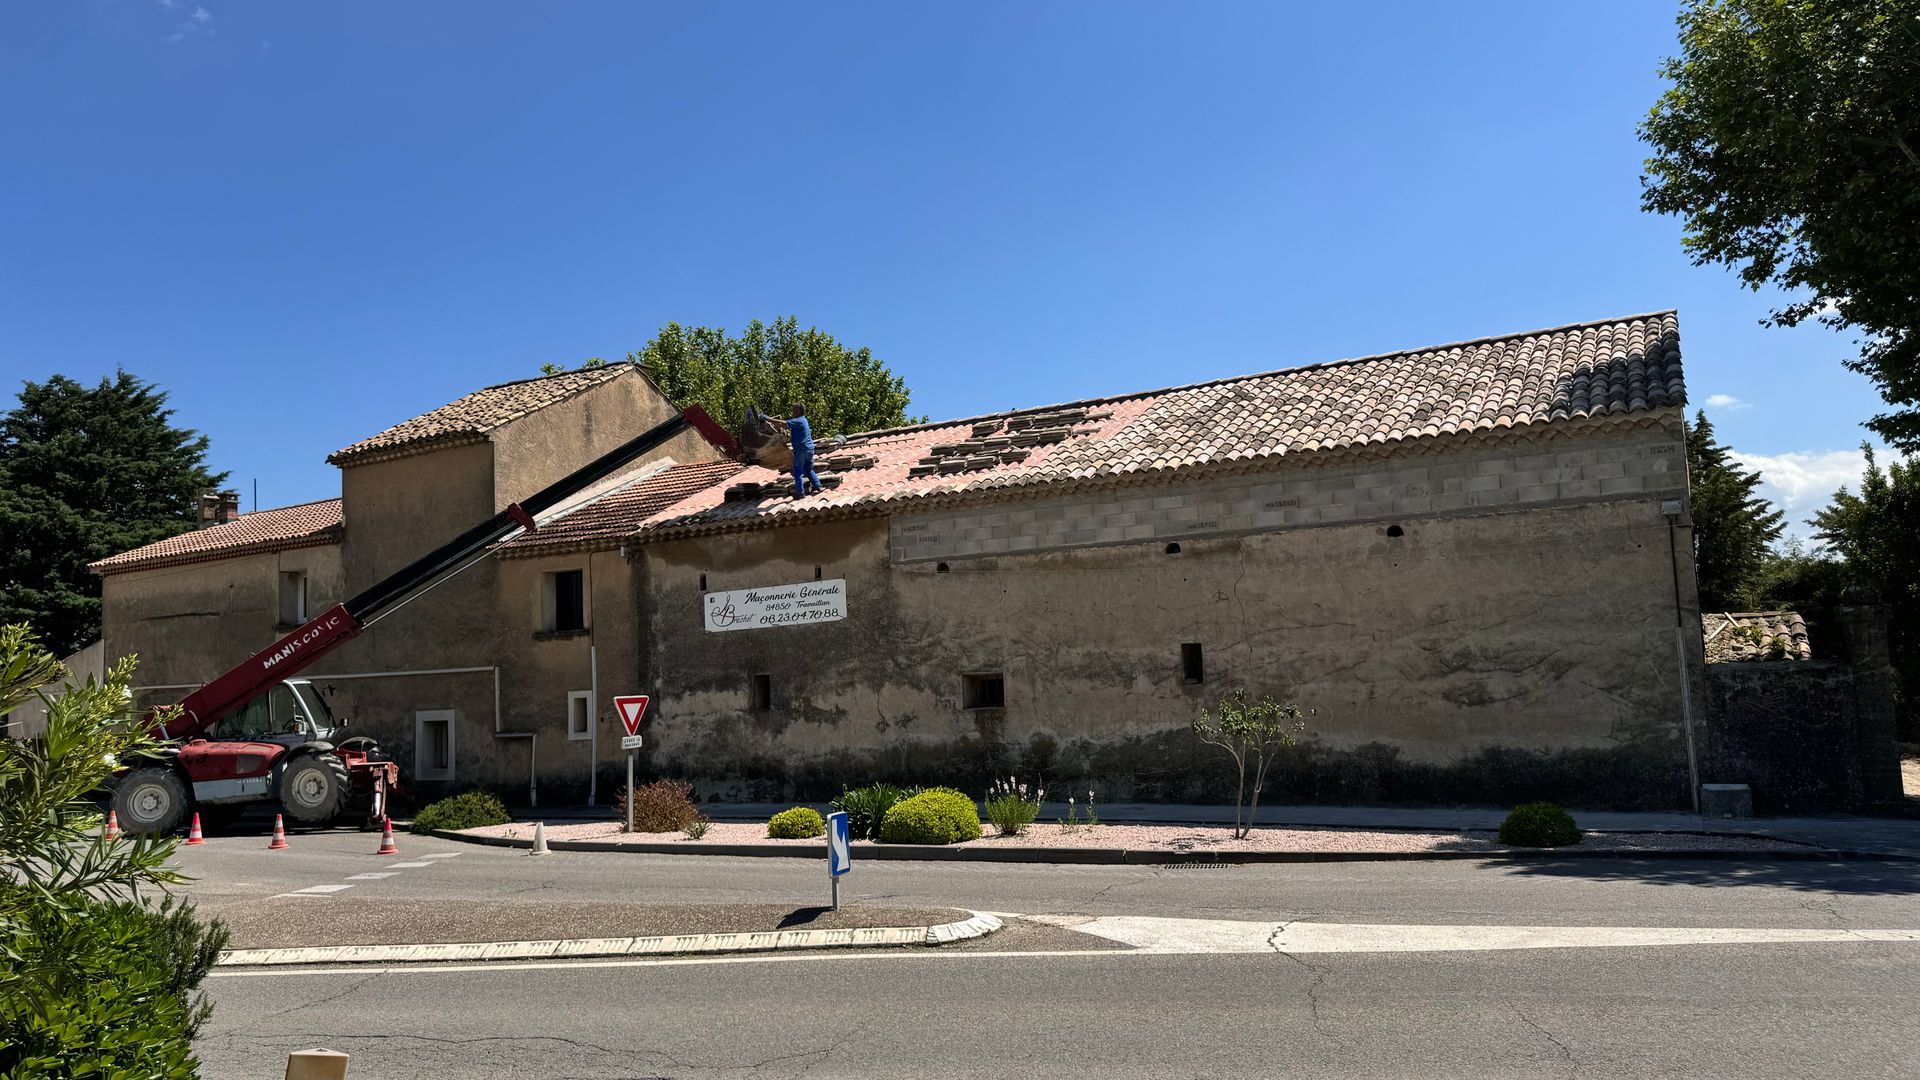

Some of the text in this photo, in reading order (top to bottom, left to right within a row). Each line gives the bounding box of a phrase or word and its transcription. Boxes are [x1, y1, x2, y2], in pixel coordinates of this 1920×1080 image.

[745, 585, 840, 604] Maçonnerie Générale
[765, 602, 791, 611] 84850
